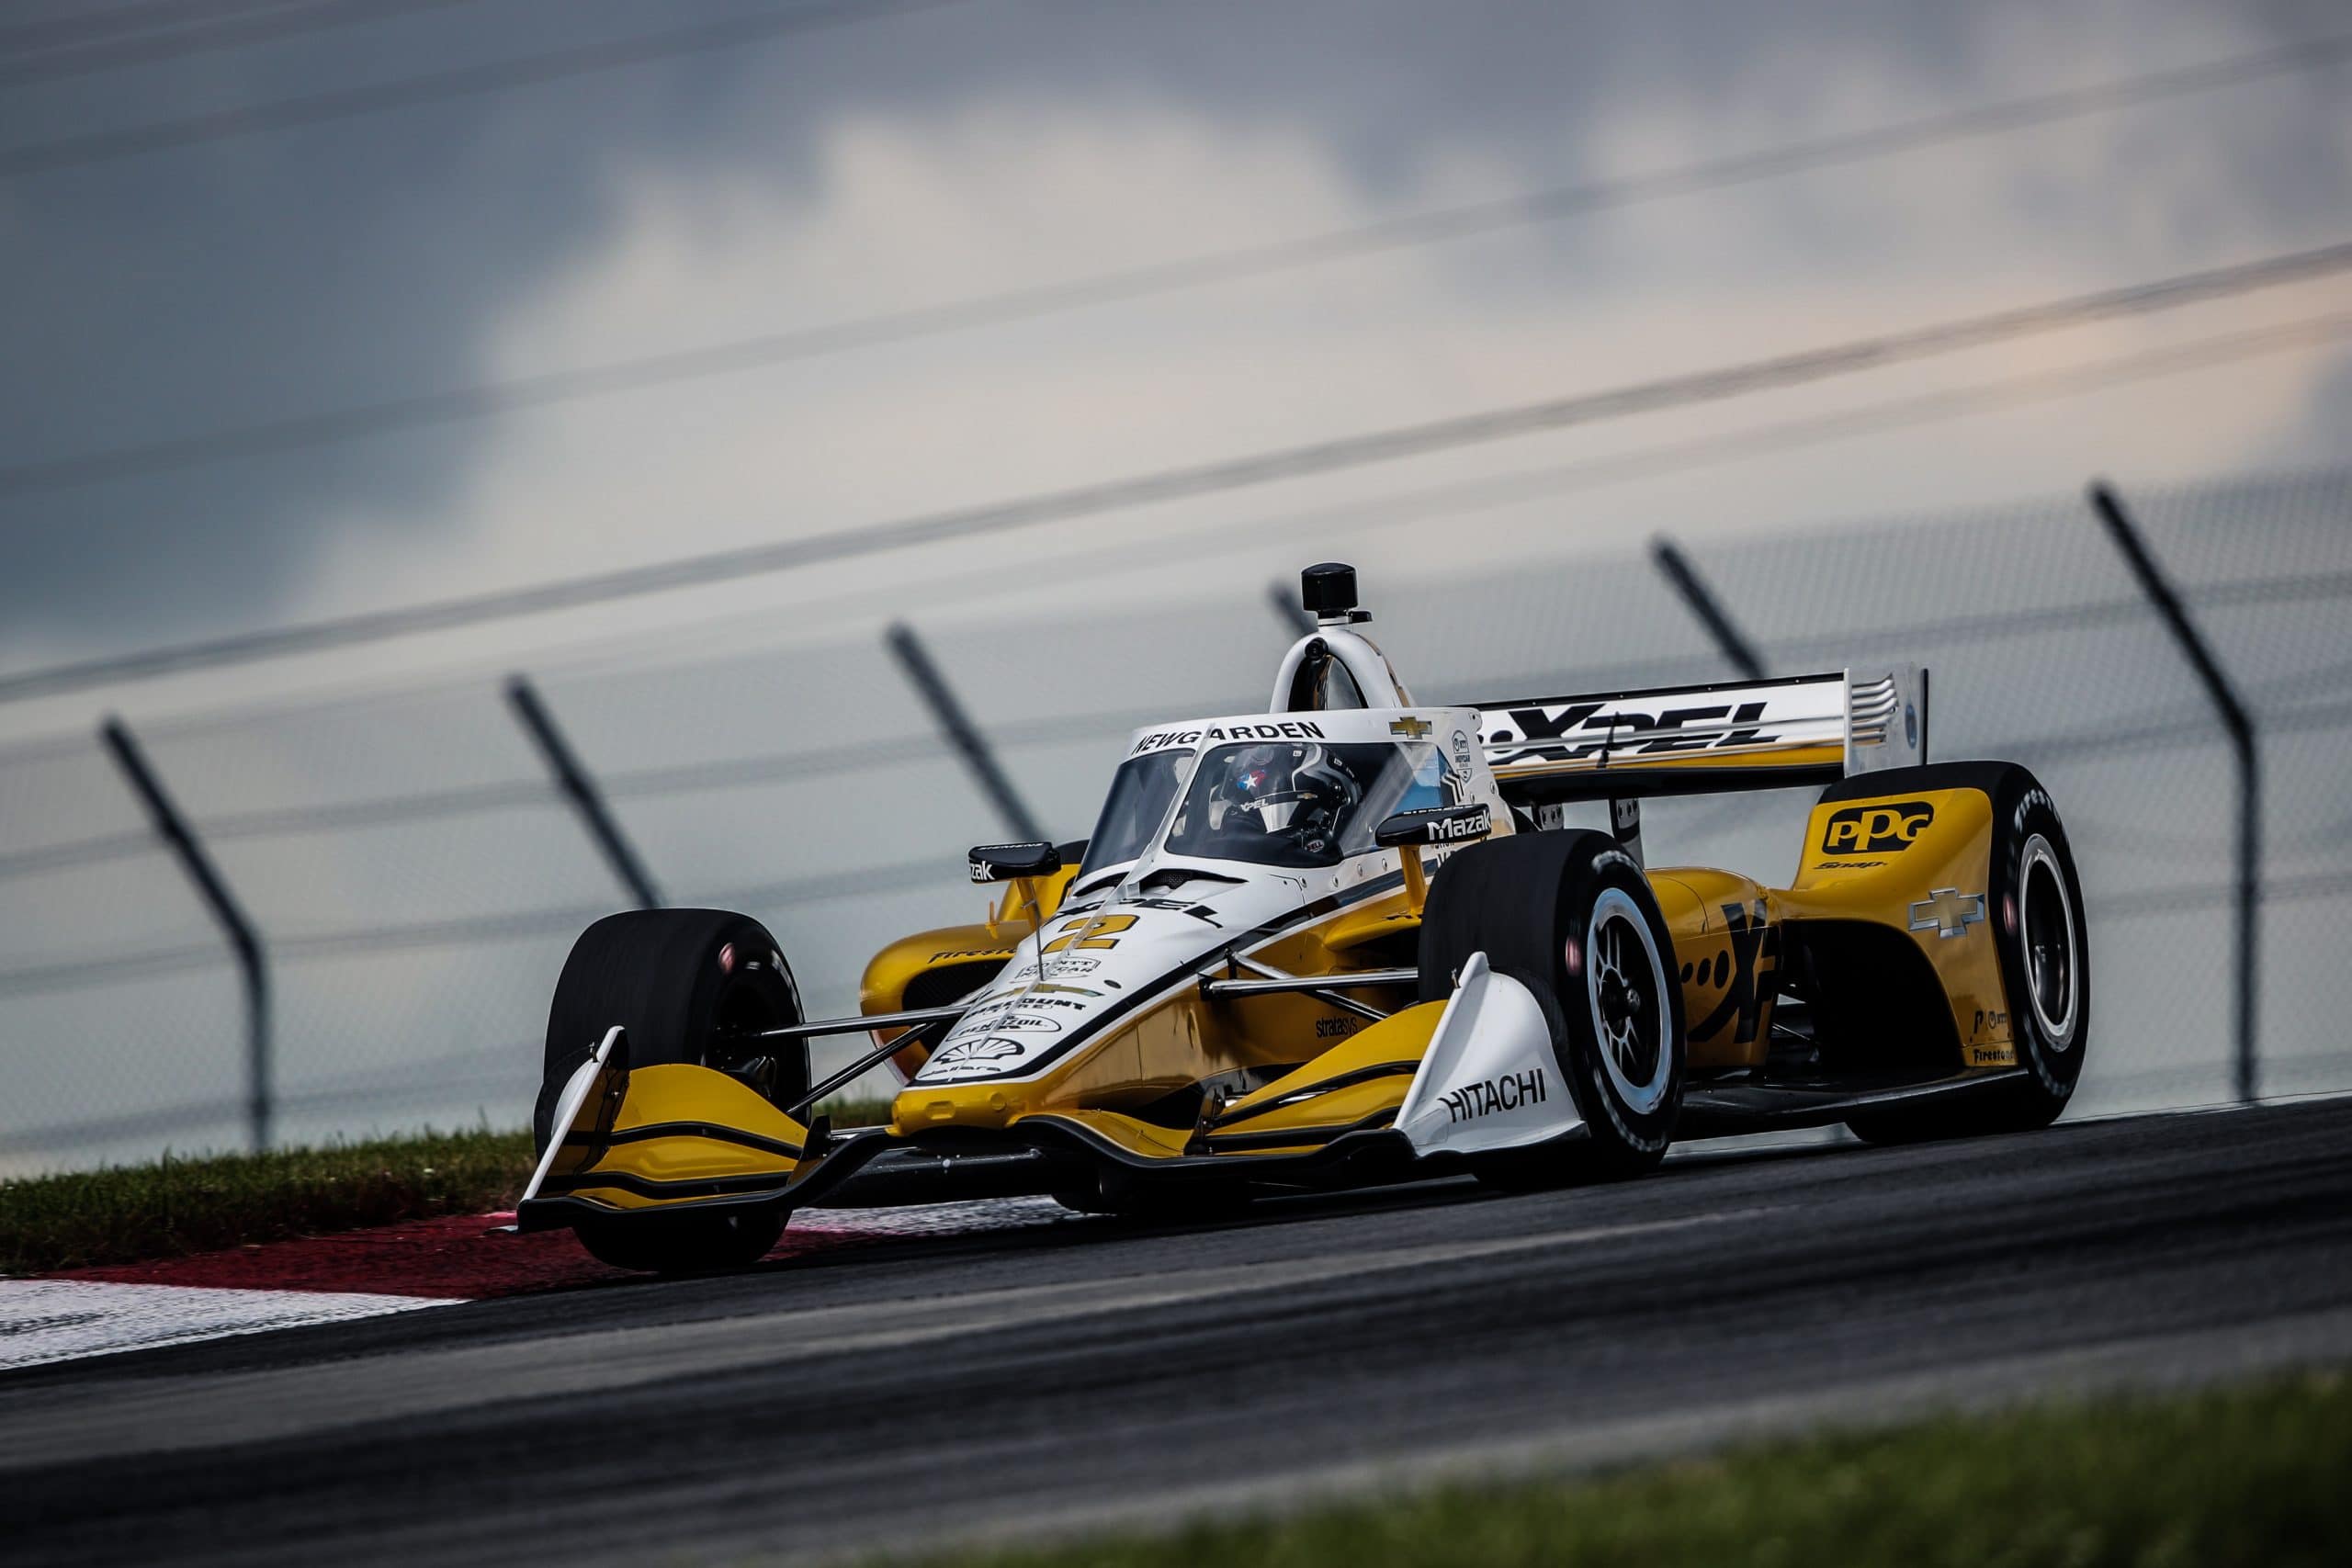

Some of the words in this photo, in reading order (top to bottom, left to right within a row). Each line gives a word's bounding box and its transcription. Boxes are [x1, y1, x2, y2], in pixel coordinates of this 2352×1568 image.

[1131, 721, 1326, 756] NEWGARDEN
[1488, 702, 1782, 765] XPEL
[1427, 809, 1491, 841] Mazak
[1826, 809, 1929, 851] PPG
[969, 861, 995, 880] zak
[1039, 898, 1224, 930] XPEL
[1040, 915, 1141, 954] 2
[1437, 1068, 1546, 1123] HITACHI
